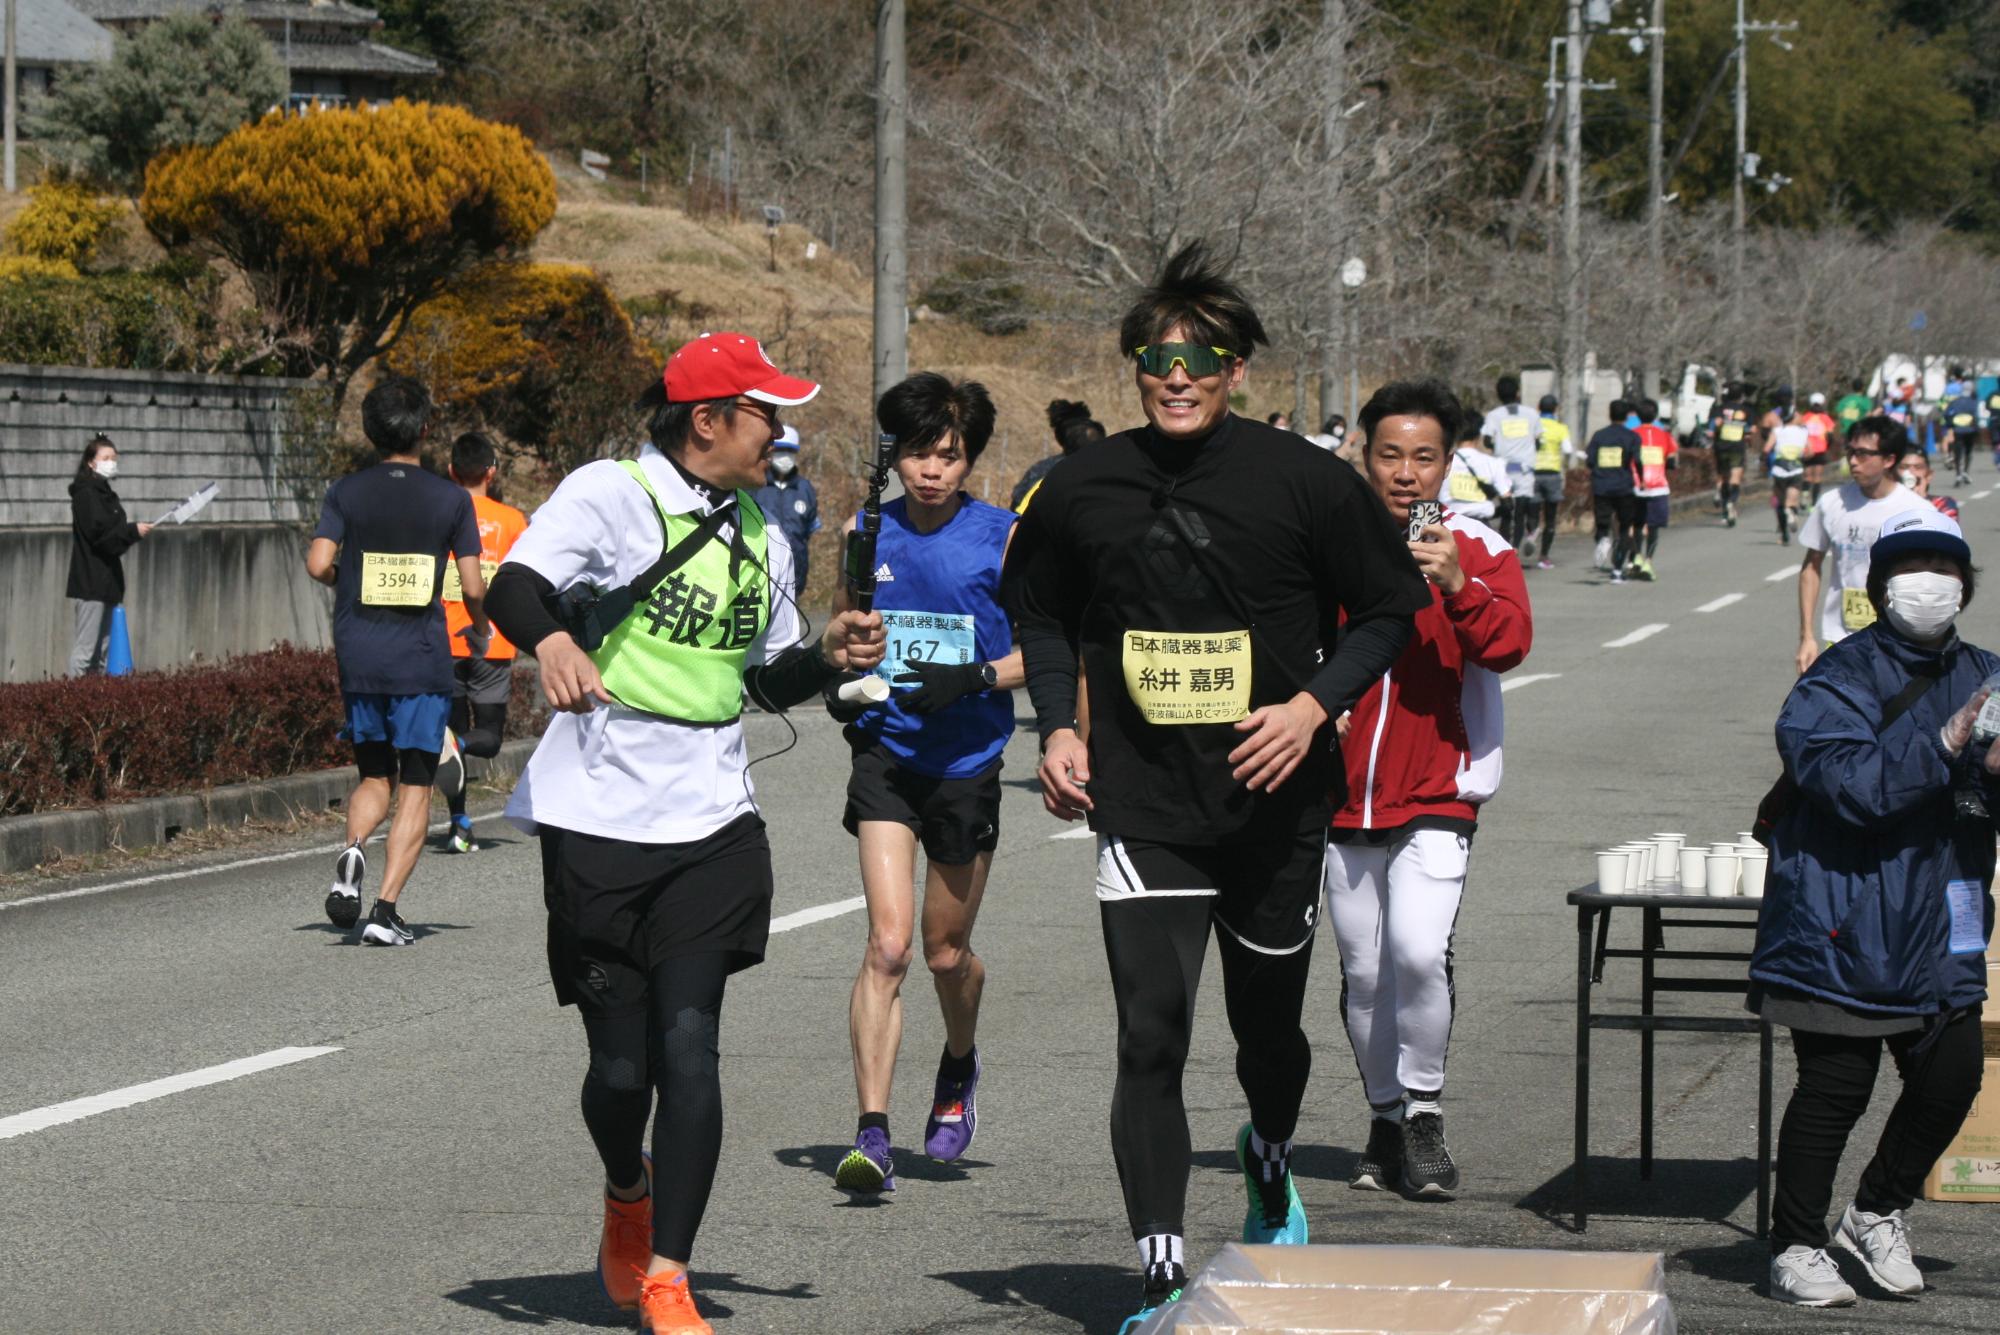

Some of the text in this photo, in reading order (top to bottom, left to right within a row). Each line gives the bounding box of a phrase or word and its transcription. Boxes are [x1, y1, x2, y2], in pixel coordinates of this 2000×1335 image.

[377, 572, 430, 589] 3594 A
[643, 572, 763, 650] 報道
[1845, 598, 1877, 617] A51
[884, 614, 967, 631] 本臓器製薬
[892, 639, 940, 662] 167
[1131, 636, 1242, 655] 日本臓器製薬
[1139, 667, 1234, 692] 糸井 嘉男
